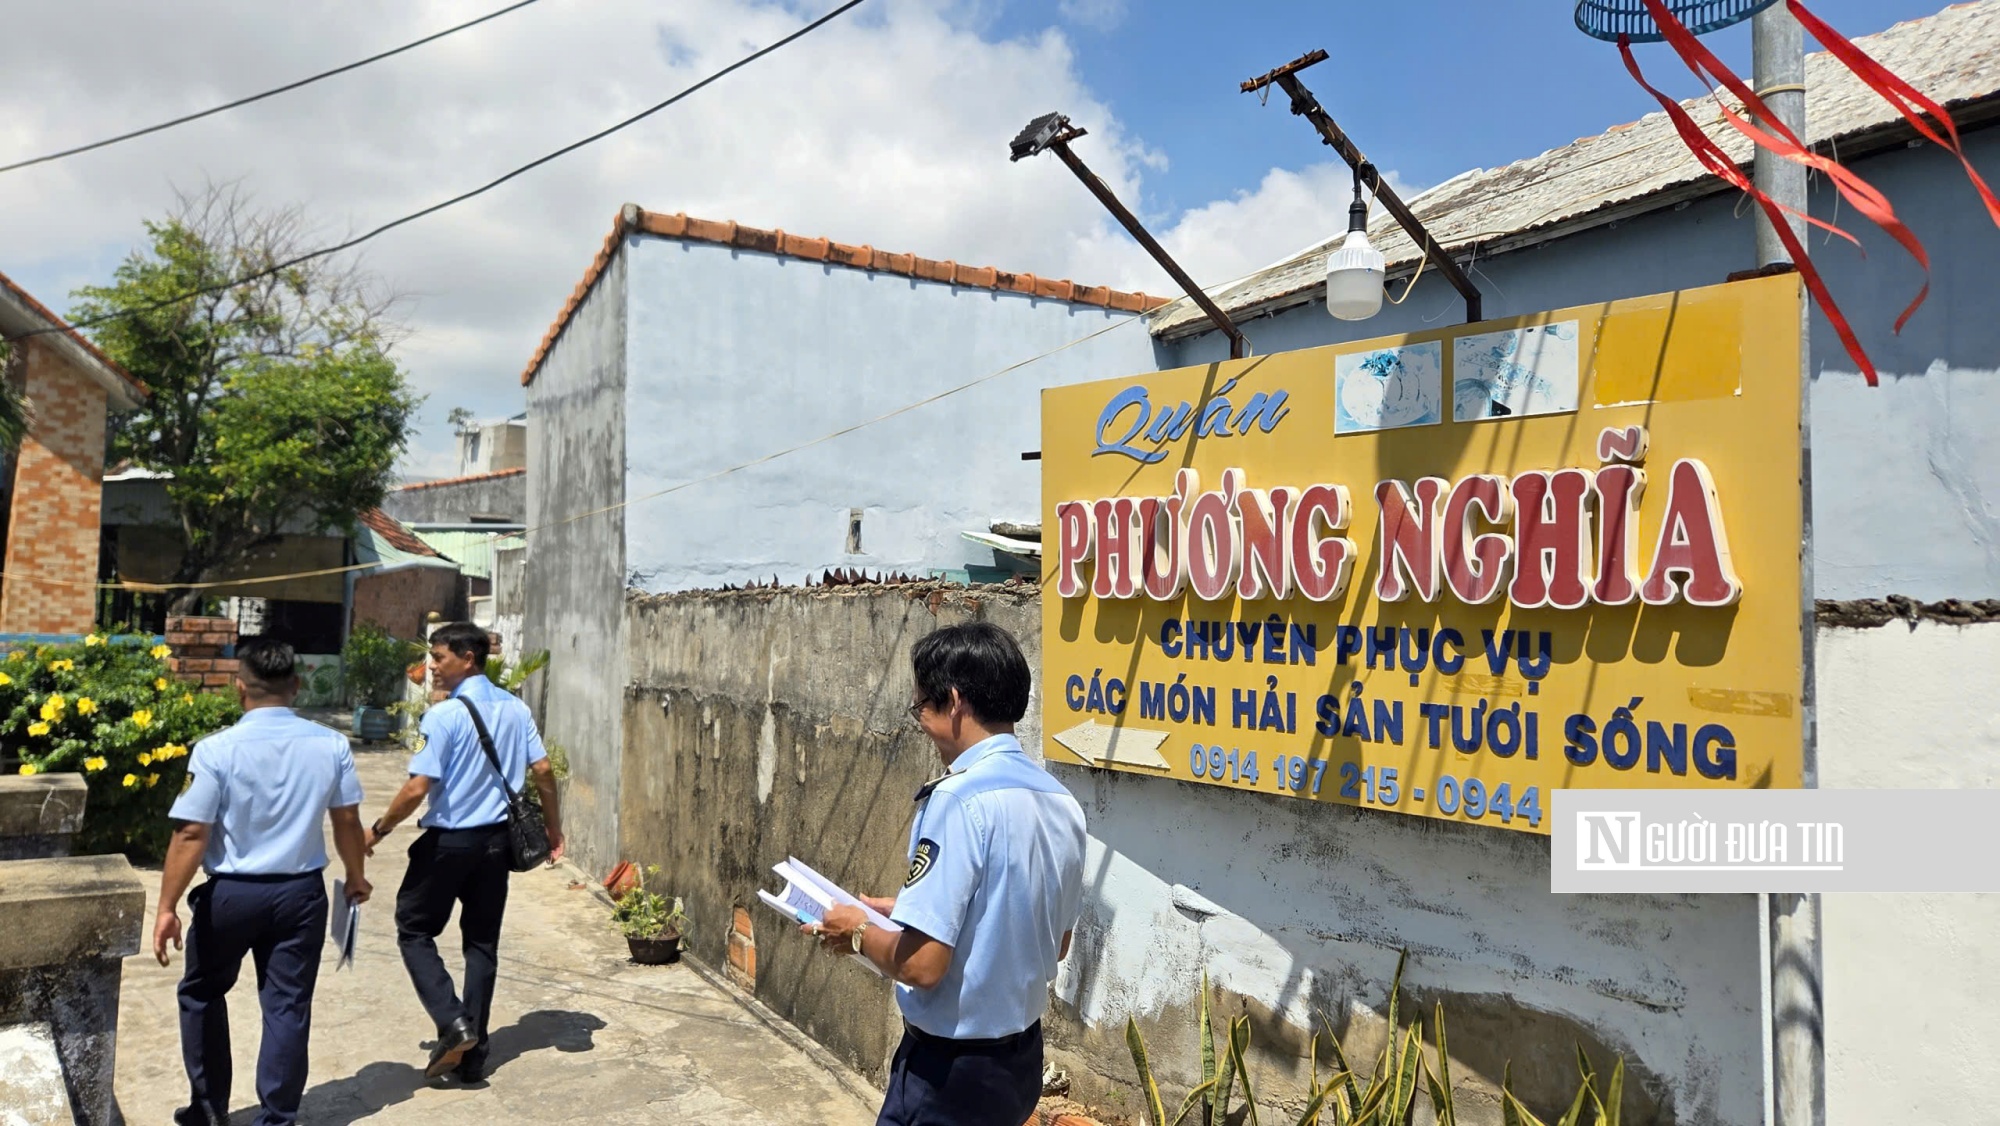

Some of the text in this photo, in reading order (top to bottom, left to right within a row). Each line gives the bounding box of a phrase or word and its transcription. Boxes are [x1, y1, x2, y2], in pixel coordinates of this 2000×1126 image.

[1092, 379, 1290, 463] Quán
[1056, 425, 1743, 609] PHƯƠNG NGHĨA
[1161, 613, 1552, 695] CHUYÊN PHỤC VỤ
[1066, 669, 1737, 781] CÁC MÓN HẢI SẢN TƯƠI SỐNG
[1190, 743, 1259, 784] 0914
[1274, 754, 1327, 794] 197
[1340, 762, 1400, 805] 215
[1437, 775, 1542, 827] 0944
